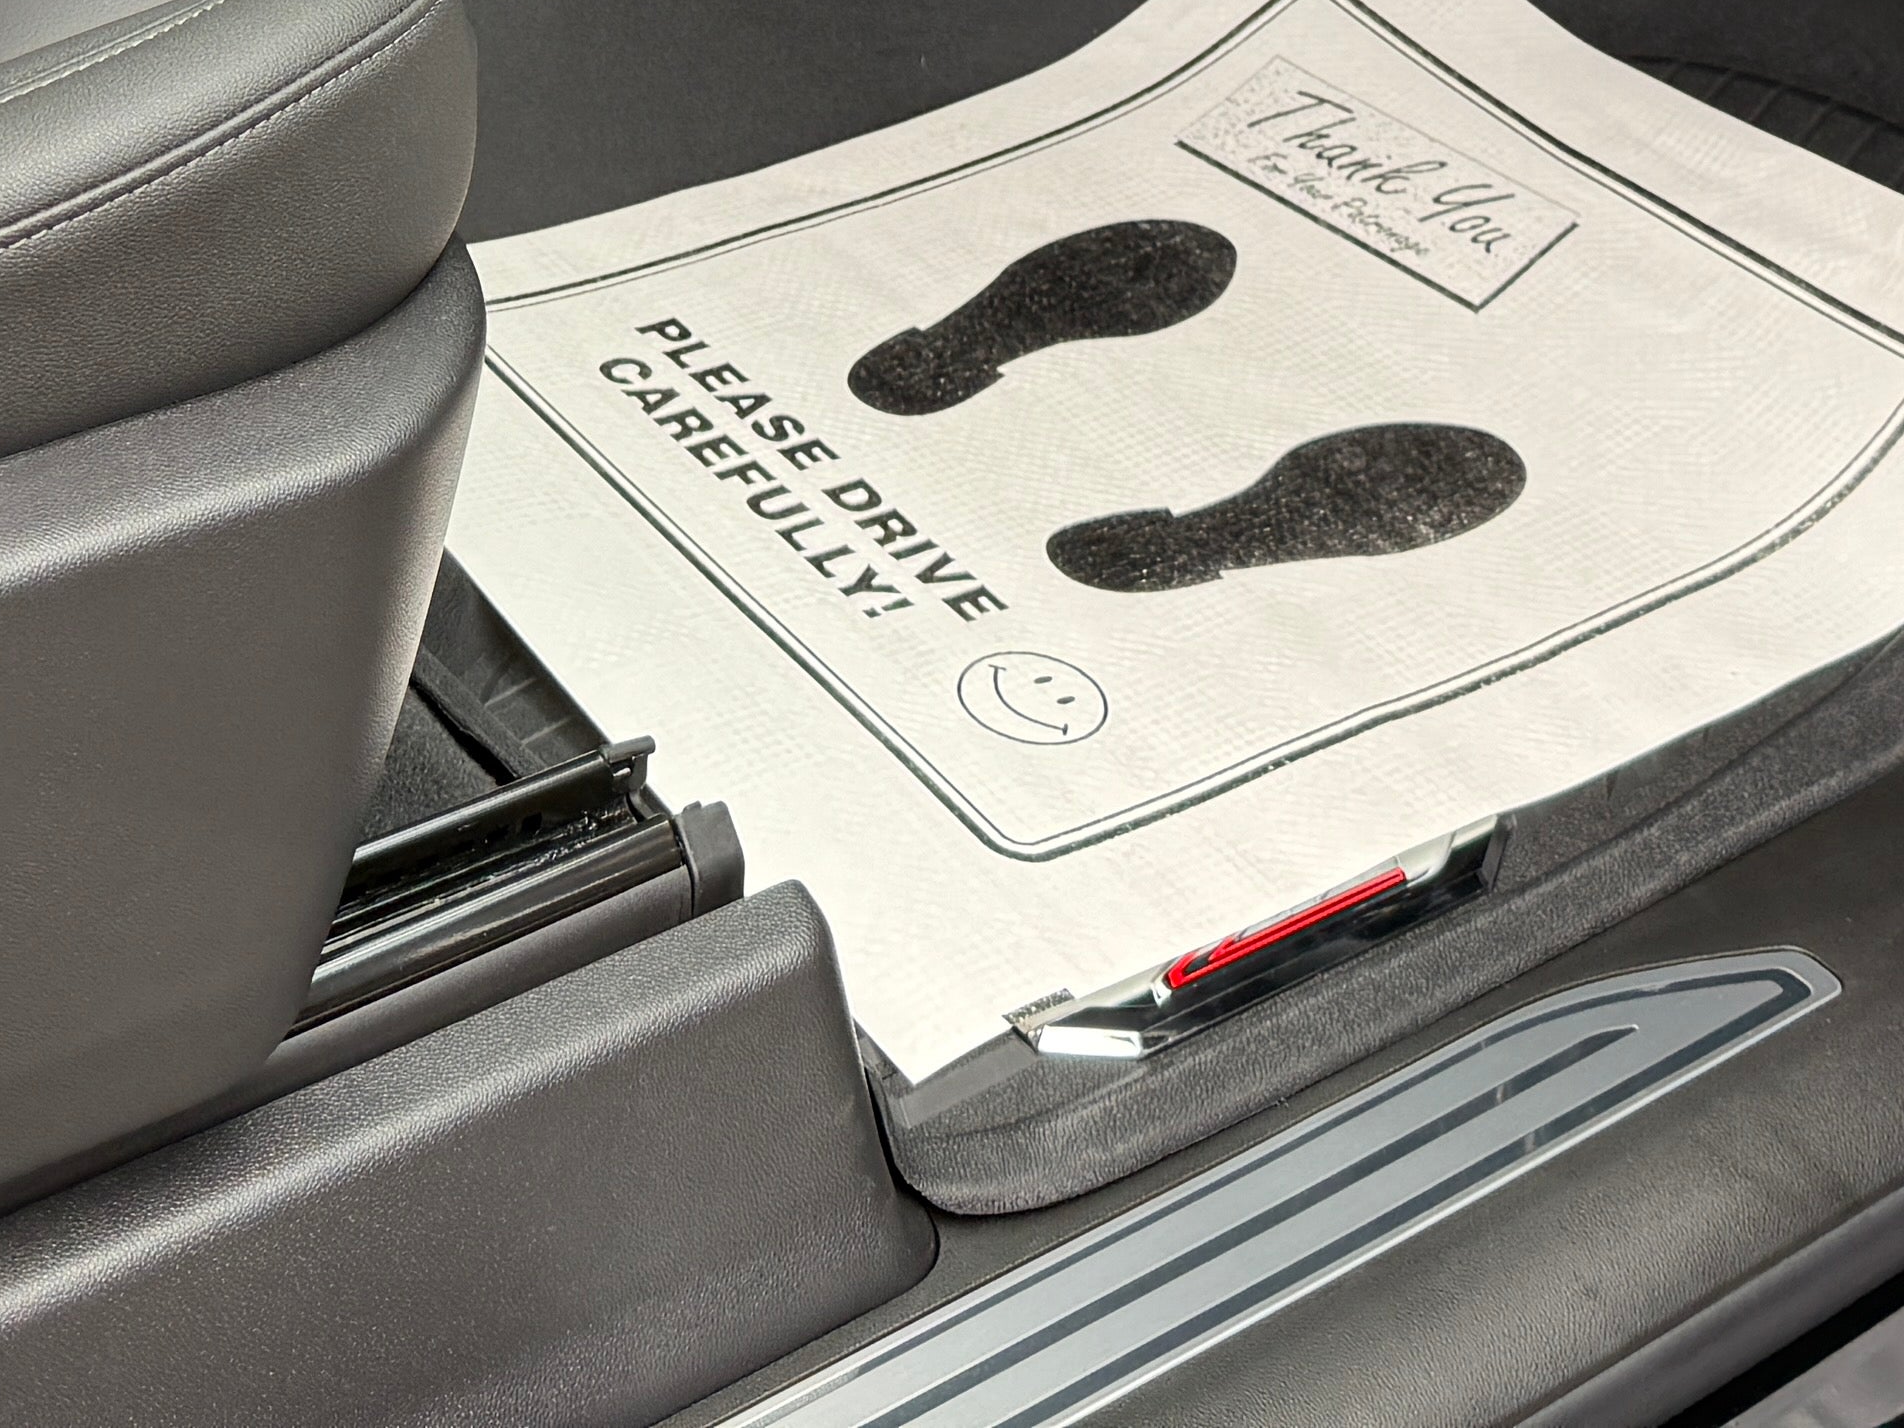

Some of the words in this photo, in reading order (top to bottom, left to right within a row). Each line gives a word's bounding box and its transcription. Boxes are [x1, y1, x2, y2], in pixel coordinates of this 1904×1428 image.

[1246, 90, 1448, 195] Thank
[1417, 183, 1516, 254] You
[597, 356, 916, 619] CAREFULLY!
[634, 316, 841, 471] PLEASE
[820, 476, 1010, 622] DRIVE
